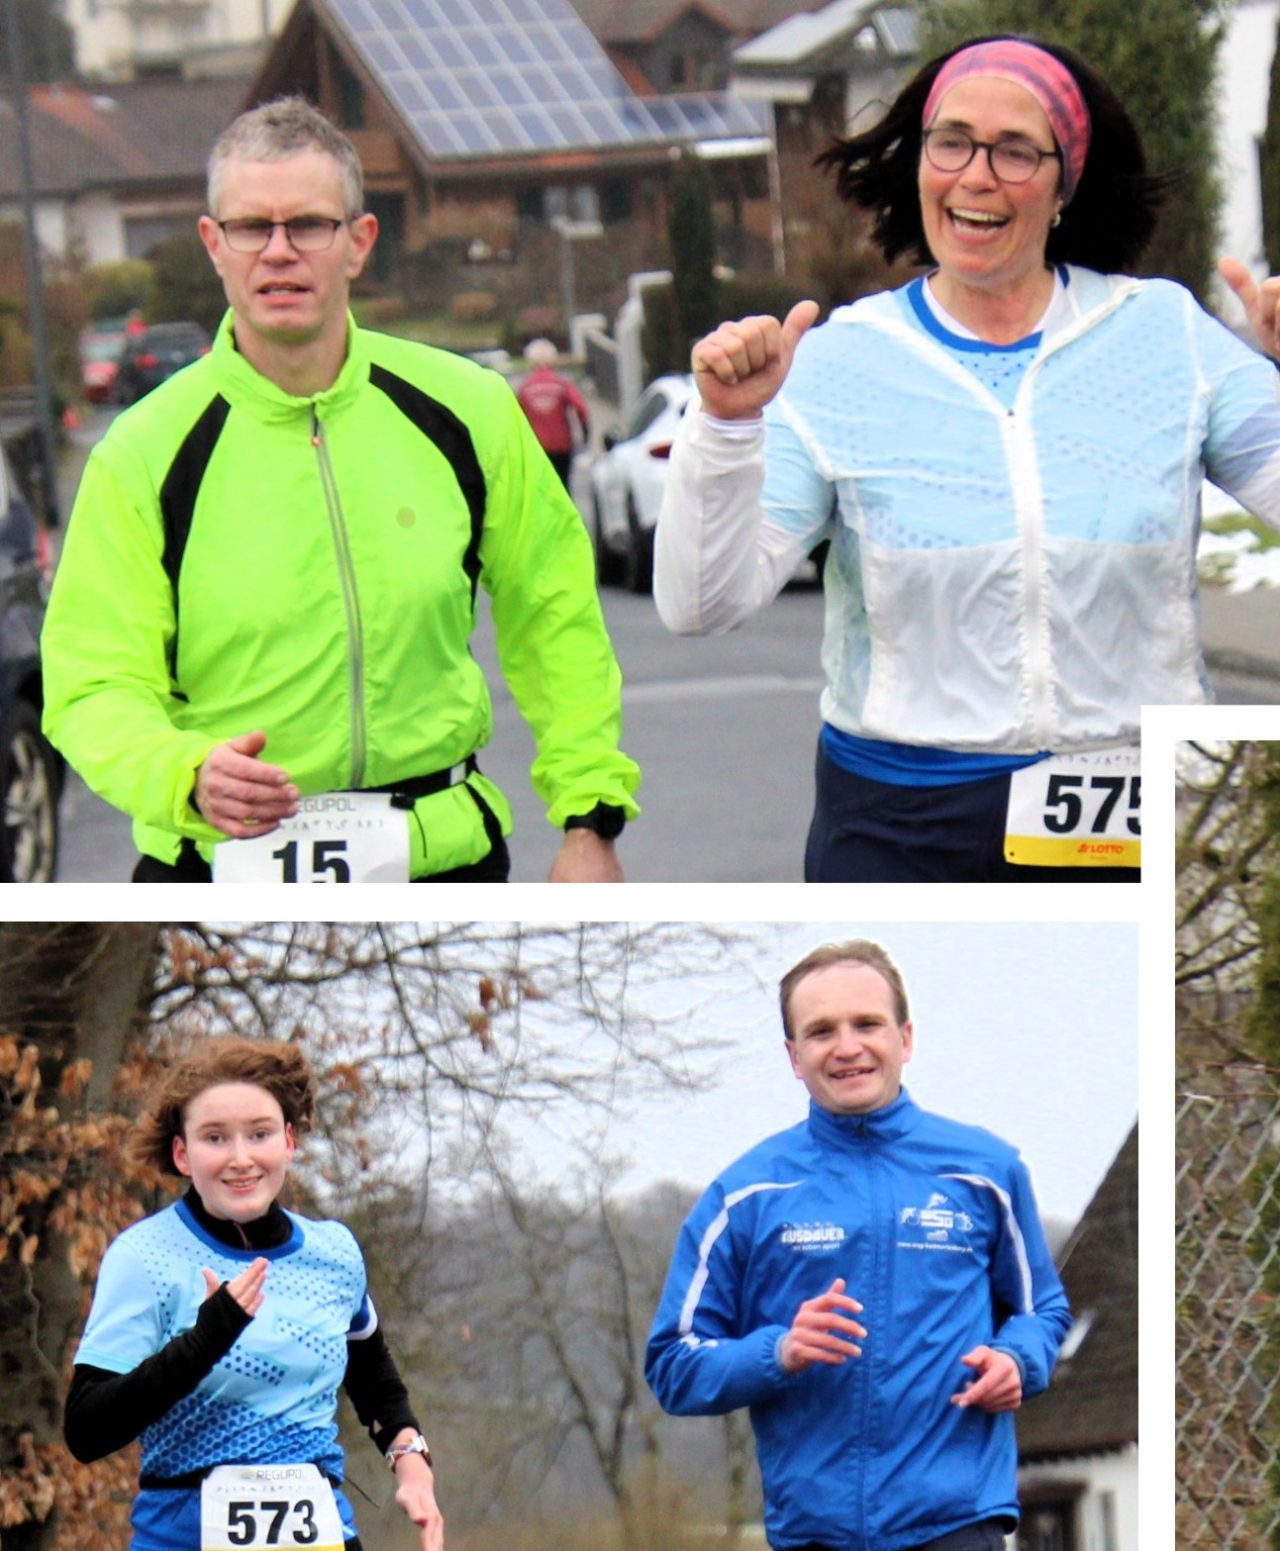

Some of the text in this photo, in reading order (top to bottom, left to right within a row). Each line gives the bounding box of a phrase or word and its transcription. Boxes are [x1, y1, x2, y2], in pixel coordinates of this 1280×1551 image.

[297, 798, 356, 813] EGUPOL
[1091, 844, 1124, 855] LOTTO
[272, 840, 350, 883] 15
[256, 1468, 304, 1481] REGUPO
[228, 1499, 318, 1546] 573
